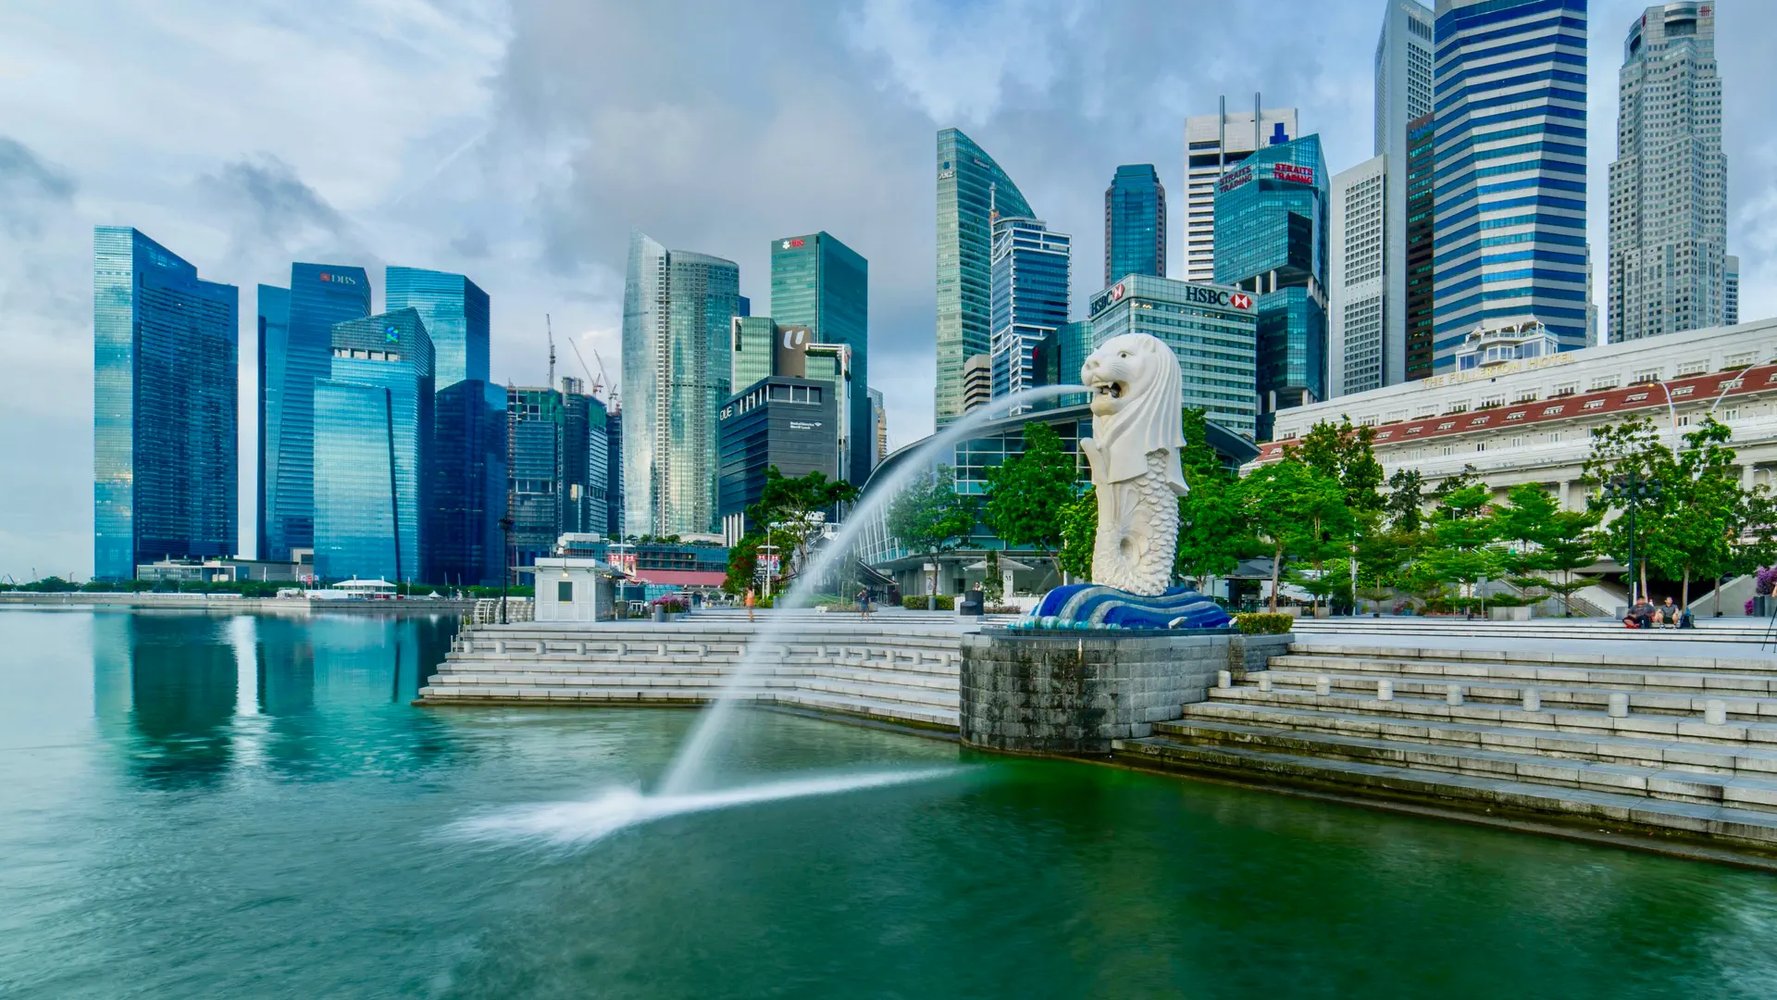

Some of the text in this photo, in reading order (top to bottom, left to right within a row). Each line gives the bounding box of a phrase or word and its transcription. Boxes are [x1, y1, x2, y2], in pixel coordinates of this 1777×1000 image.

[1275, 163, 1313, 175] STRAITS
[1274, 172, 1313, 184] TRADING
[331, 274, 356, 285] DBS
[1091, 290, 1113, 315] HSBC
[1186, 286, 1229, 306] HSBC
[1422, 377, 1444, 389] THE
[1528, 352, 1575, 370] HOTEL
